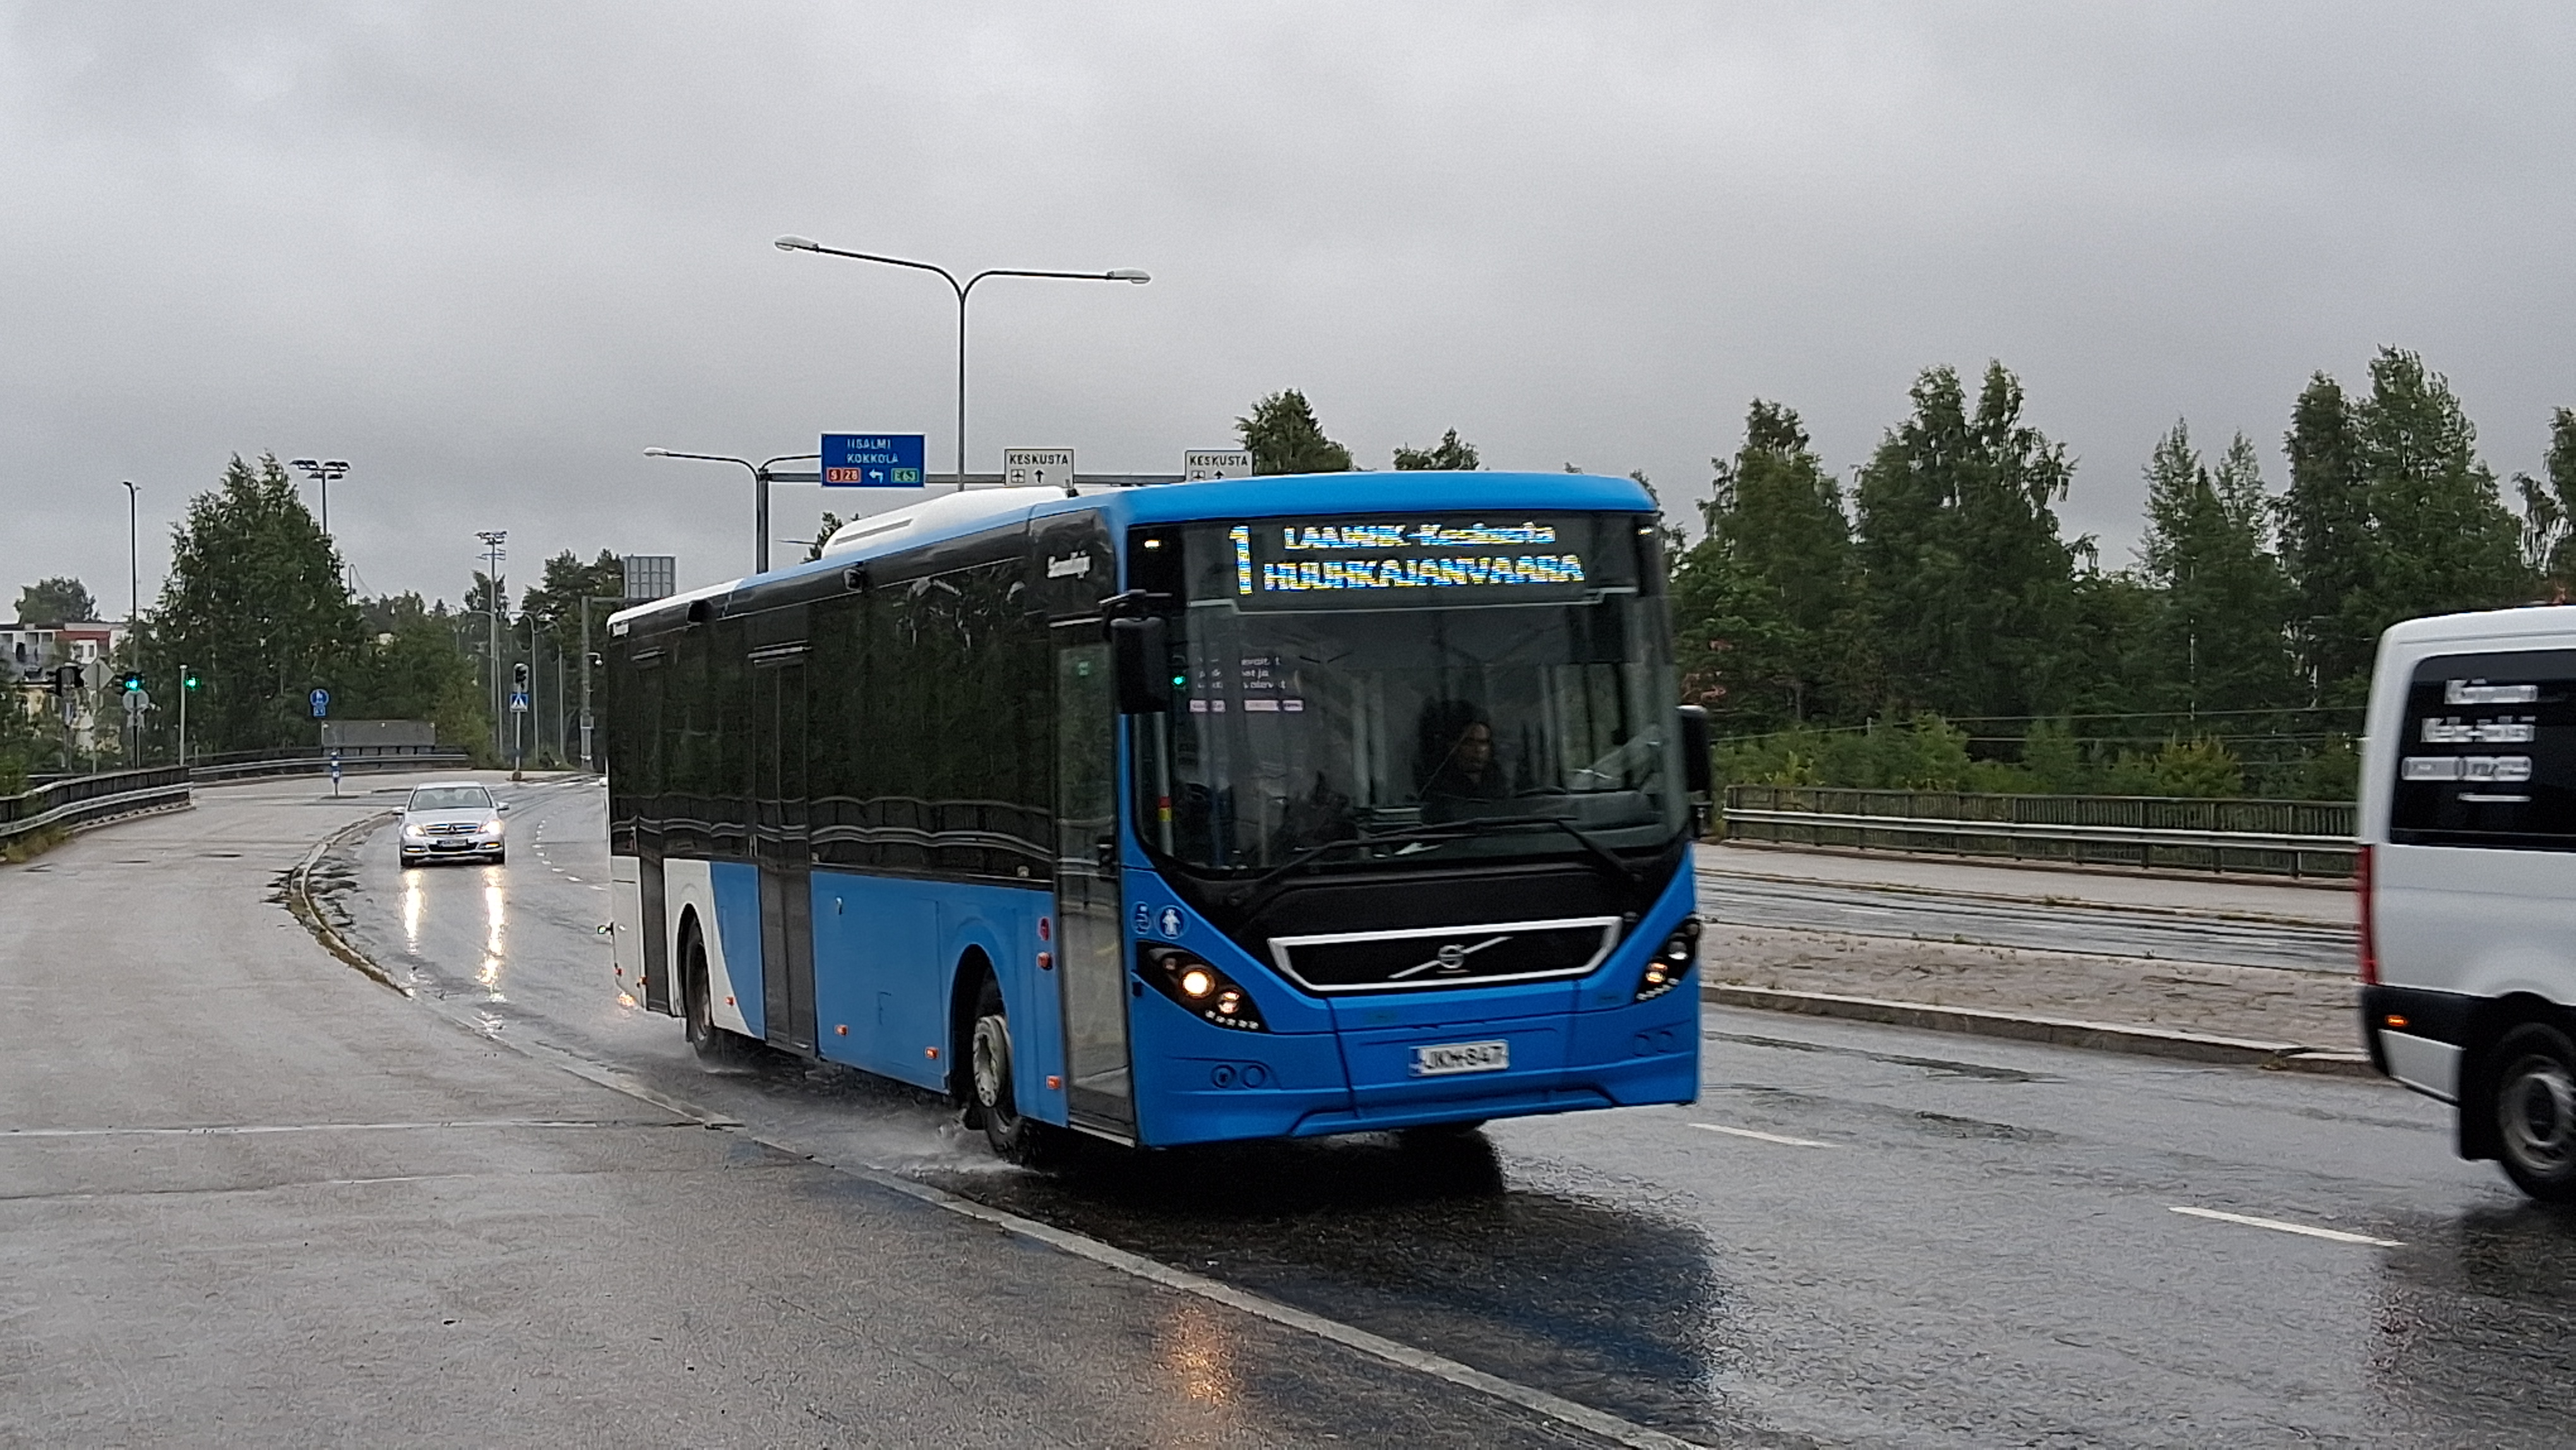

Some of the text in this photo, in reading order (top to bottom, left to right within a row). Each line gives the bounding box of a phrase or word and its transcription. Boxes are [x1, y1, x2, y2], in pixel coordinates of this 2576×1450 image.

[847, 438, 891, 450] IISALMI
[847, 453, 899, 464] KOKKOLA
[1010, 453, 1069, 465] KESKUSTA
[1190, 454, 1248, 467] KESKUSTA
[844, 470, 858, 481] 28
[1229, 525, 1253, 595] 1
